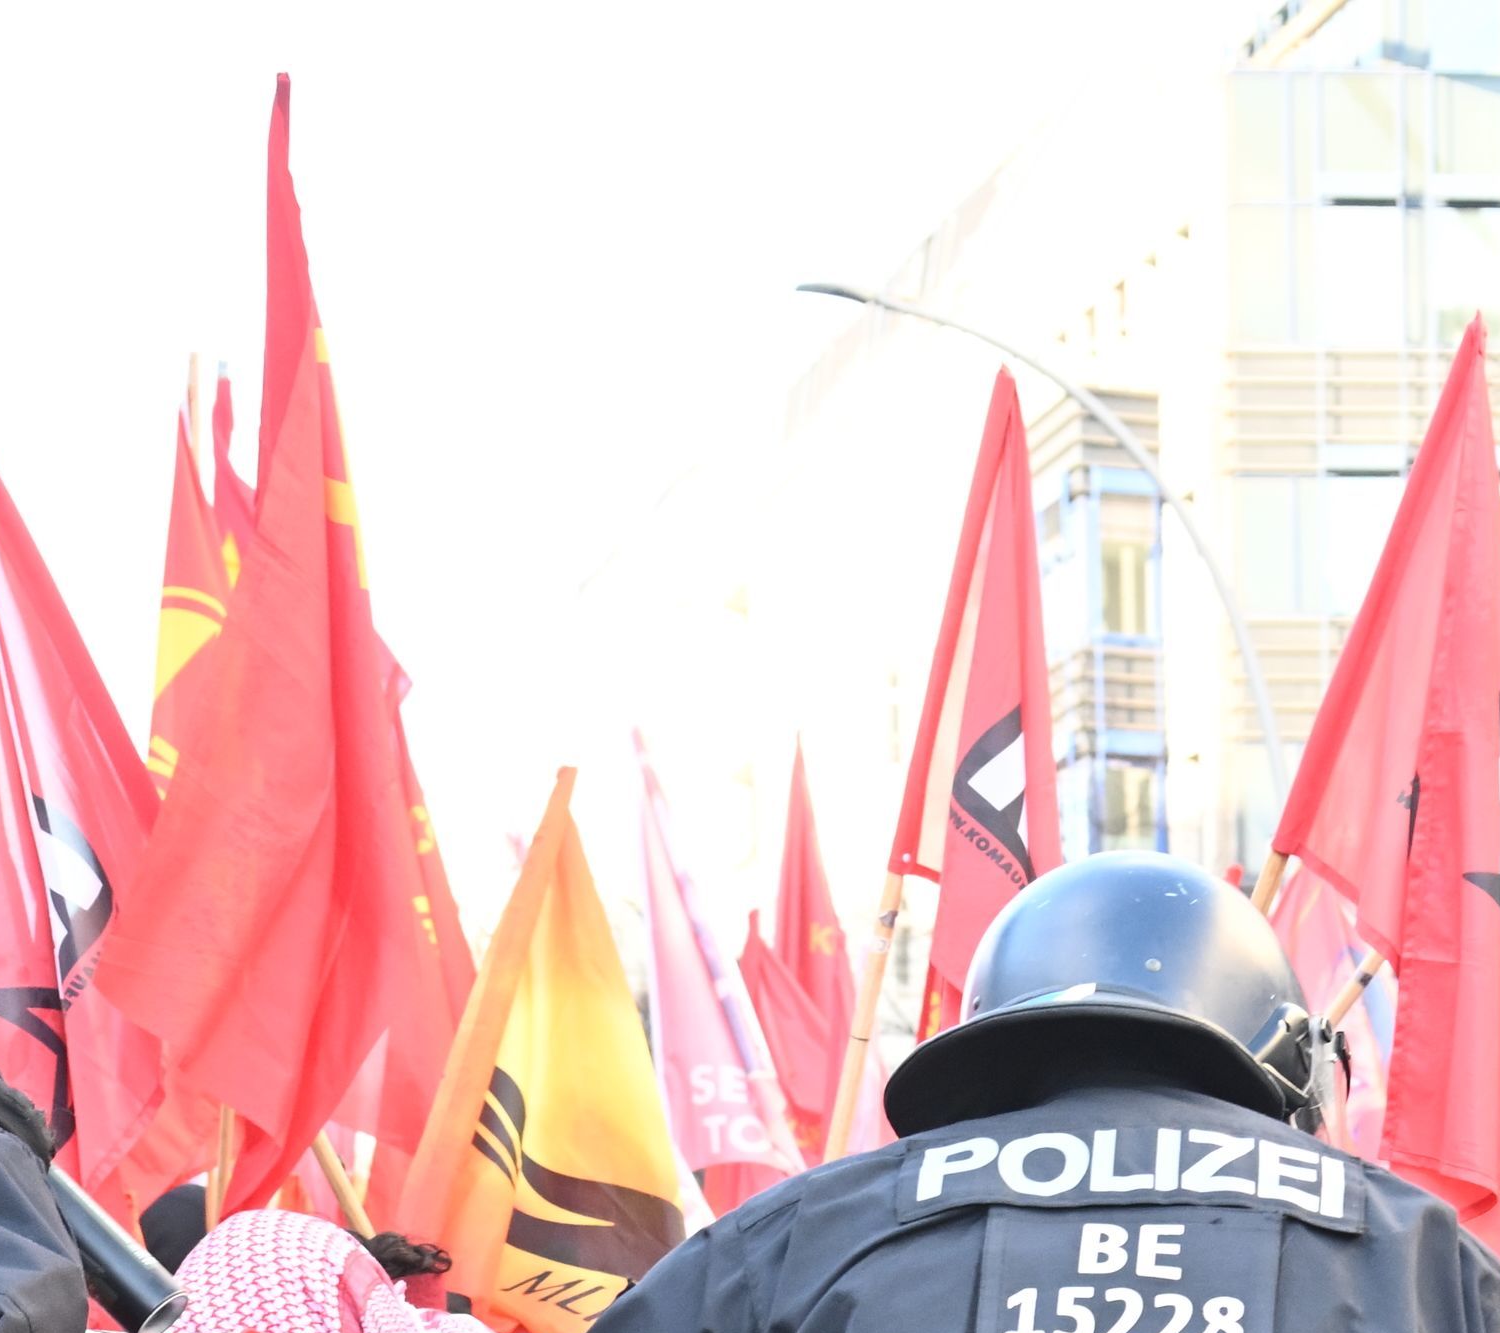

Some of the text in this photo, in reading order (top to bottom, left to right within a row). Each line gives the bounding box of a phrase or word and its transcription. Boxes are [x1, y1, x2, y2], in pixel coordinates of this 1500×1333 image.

[916, 1128, 1346, 1219] POLIZEI
[1077, 1223, 1187, 1280] BE
[500, 1270, 606, 1322] ML
